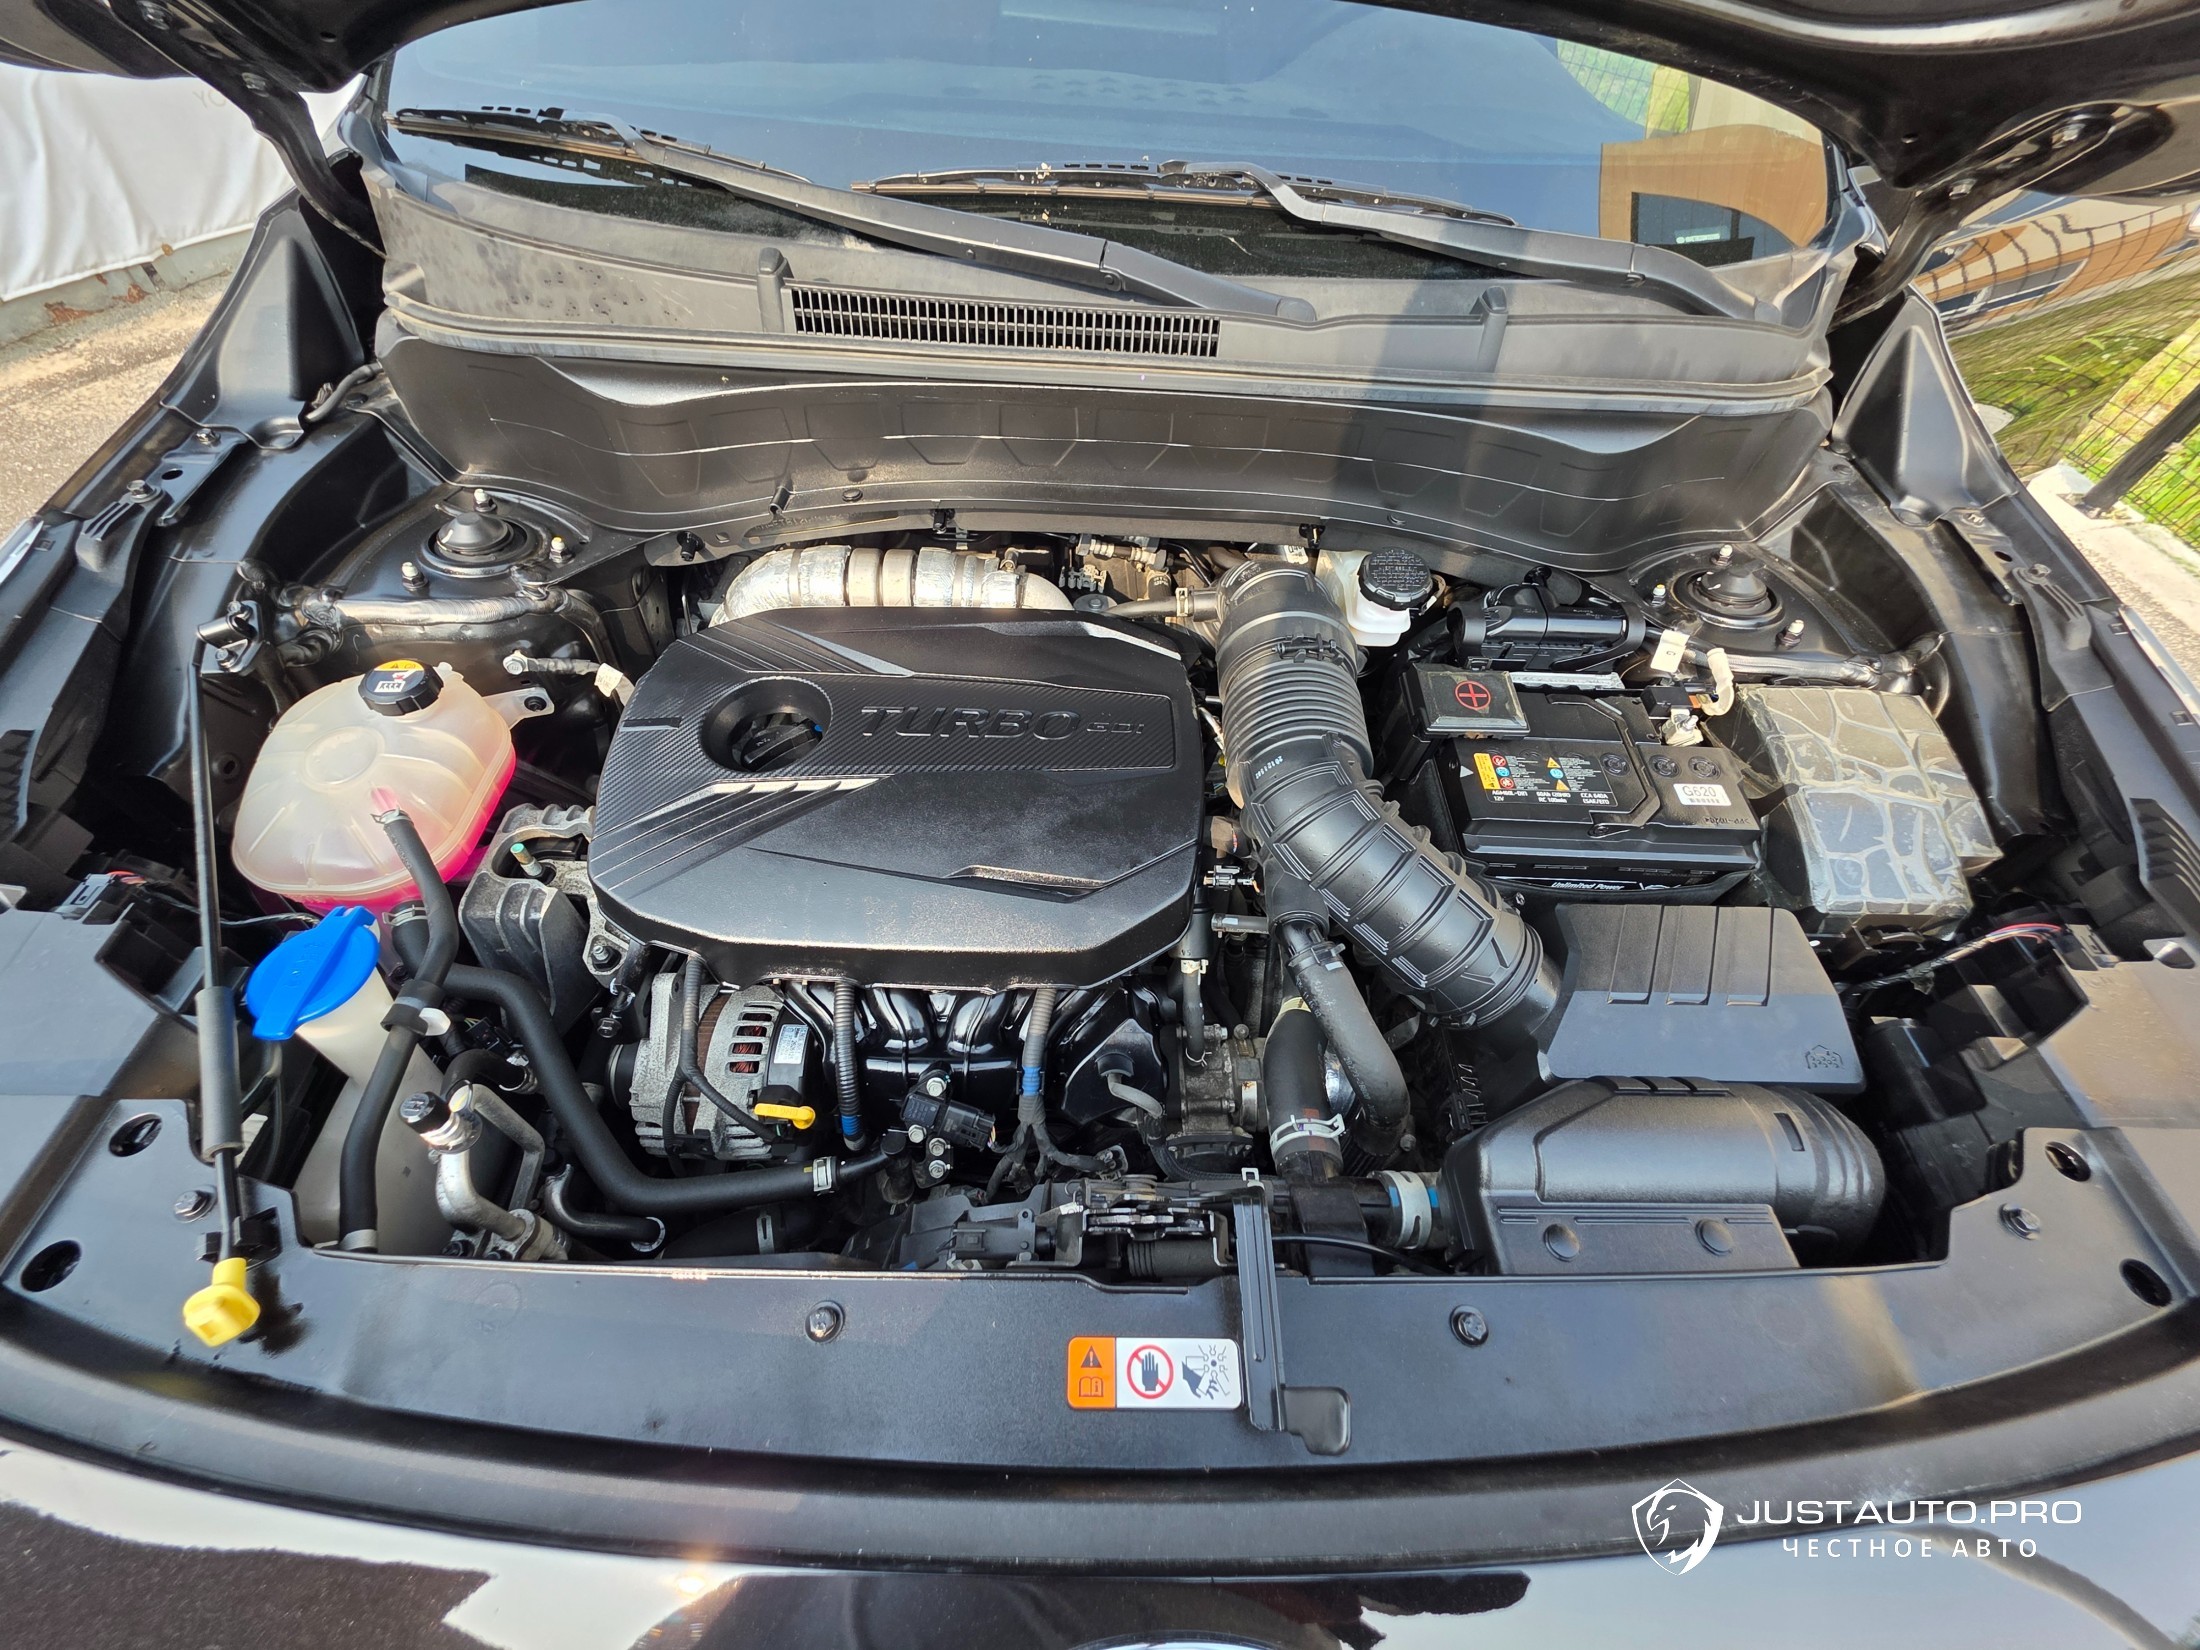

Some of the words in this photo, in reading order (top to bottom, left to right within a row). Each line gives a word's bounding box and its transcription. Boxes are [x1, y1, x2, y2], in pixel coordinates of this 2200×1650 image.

[861, 706, 1081, 740] TURBO
[1086, 722, 1145, 734] GDI
[1682, 785, 1717, 797] G620
[1551, 881, 1595, 890] Unlimited
